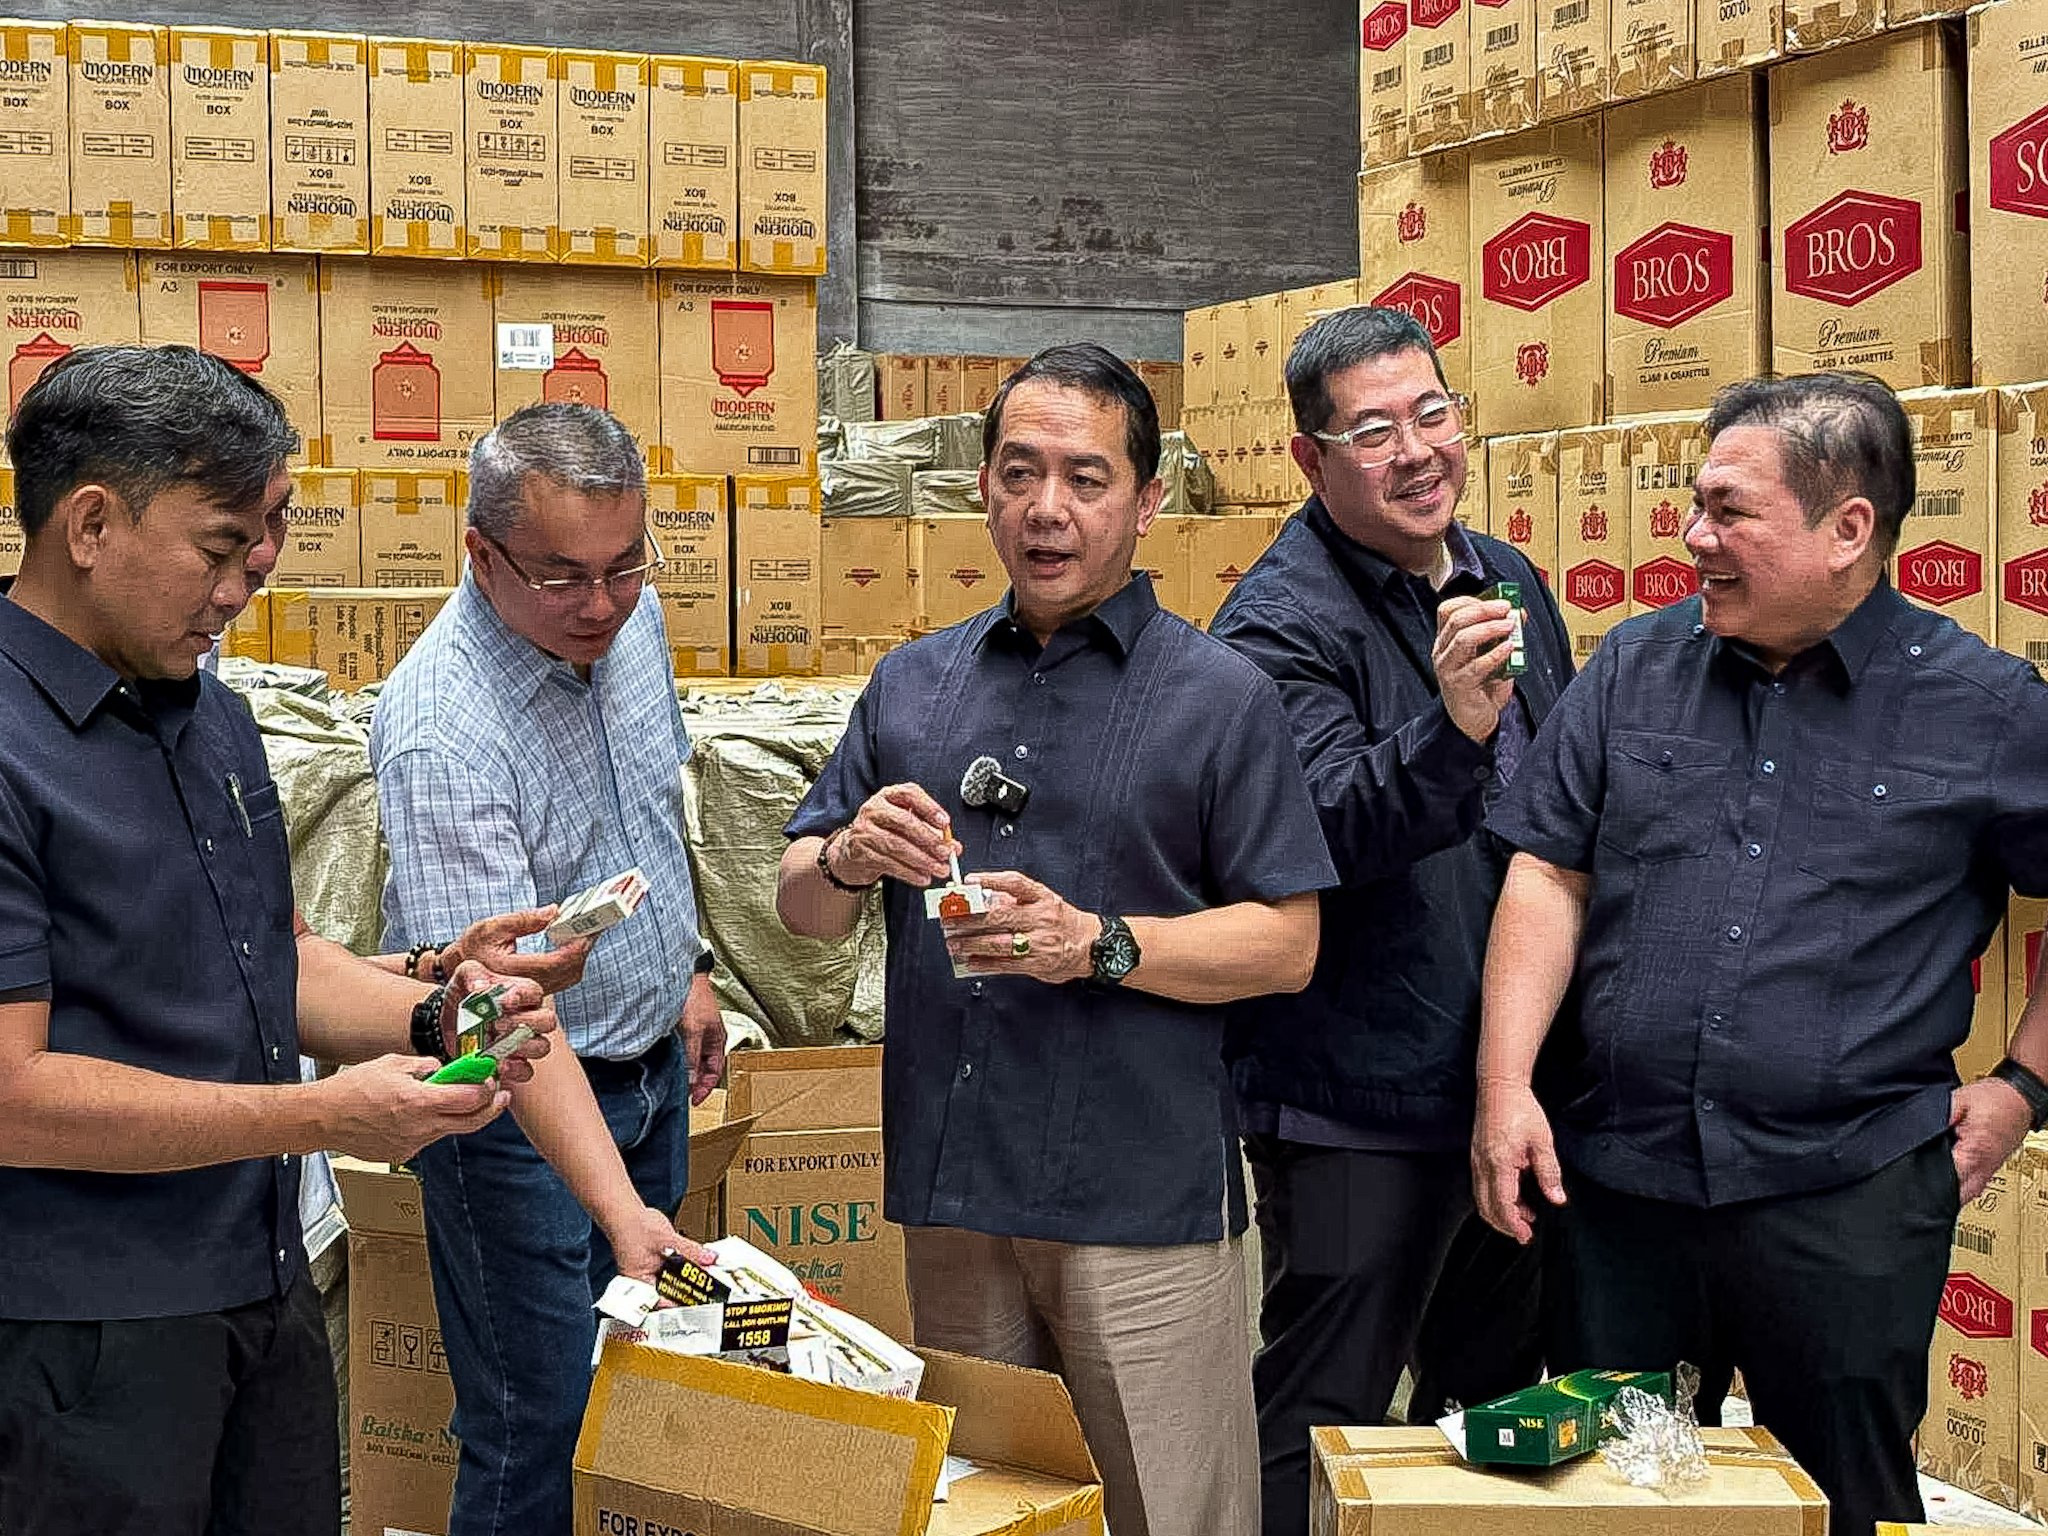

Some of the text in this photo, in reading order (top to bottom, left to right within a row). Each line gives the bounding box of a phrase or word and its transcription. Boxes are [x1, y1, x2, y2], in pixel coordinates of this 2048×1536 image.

[1370, 11, 1401, 41] BROS
[82, 61, 153, 80] MODERN
[183, 65, 254, 85] MODERN
[477, 79, 544, 99] MODERN
[570, 87, 636, 106] MODERN
[3, 97, 29, 108] BOX
[105, 100, 130, 110] BOX
[206, 105, 231, 115] BOX
[500, 119, 522, 129] BOX
[591, 125, 614, 135] BOX
[308, 168, 333, 178] BOX
[409, 175, 432, 185] BOX
[684, 188, 706, 198] BOX
[775, 192, 796, 202] BOX
[287, 198, 356, 219] MODERN
[386, 205, 454, 224] MODERN
[663, 216, 726, 236] MODERN
[754, 220, 816, 239] MODERN
[1806, 218, 1896, 279] BROS
[155, 262, 255, 274] FOR EXPORT ONLY
[1499, 236, 1567, 288] BROS
[1632, 248, 1710, 302] BROS
[160, 282, 178, 293] A3
[673, 283, 761, 295] FOR EXPORT ONLY
[677, 301, 694, 312] A3
[1385, 294, 1443, 333] OS
[7, 311, 81, 330] MODERN
[372, 321, 442, 341] MODERN
[553, 328, 608, 347] MODER
[1818, 318, 1880, 347] Premium
[1643, 338, 1698, 364] Premium
[1813, 351, 1894, 369] CLASS A CIGARETTES
[710, 399, 775, 418] MODERN
[387, 448, 415, 458] ONLY
[417, 449, 457, 458] EXPORT
[1914, 450, 1965, 473] Premiu
[653, 509, 715, 527] MODERN
[298, 542, 322, 551] BOX
[674, 544, 696, 554] BOX
[1911, 559, 1967, 587] BROS
[1575, 574, 1615, 598] BROS
[1643, 573, 1688, 598] BROS
[770, 601, 791, 611] BOX
[750, 626, 811, 646] MODERN
[745, 1152, 881, 1174] FOR EXPORT ONLY
[745, 1201, 878, 1247] NISE
[681, 1262, 715, 1292] 1558
[725, 1307, 748, 1317] STOP
[1941, 1284, 1997, 1328] BROS
[724, 1320, 740, 1329] CALL
[737, 1330, 771, 1347] 1558
[1518, 1417, 1545, 1429] NISE
[1946, 1418, 1985, 1446] 10.000
[599, 1509, 697, 1536] FOR EX
